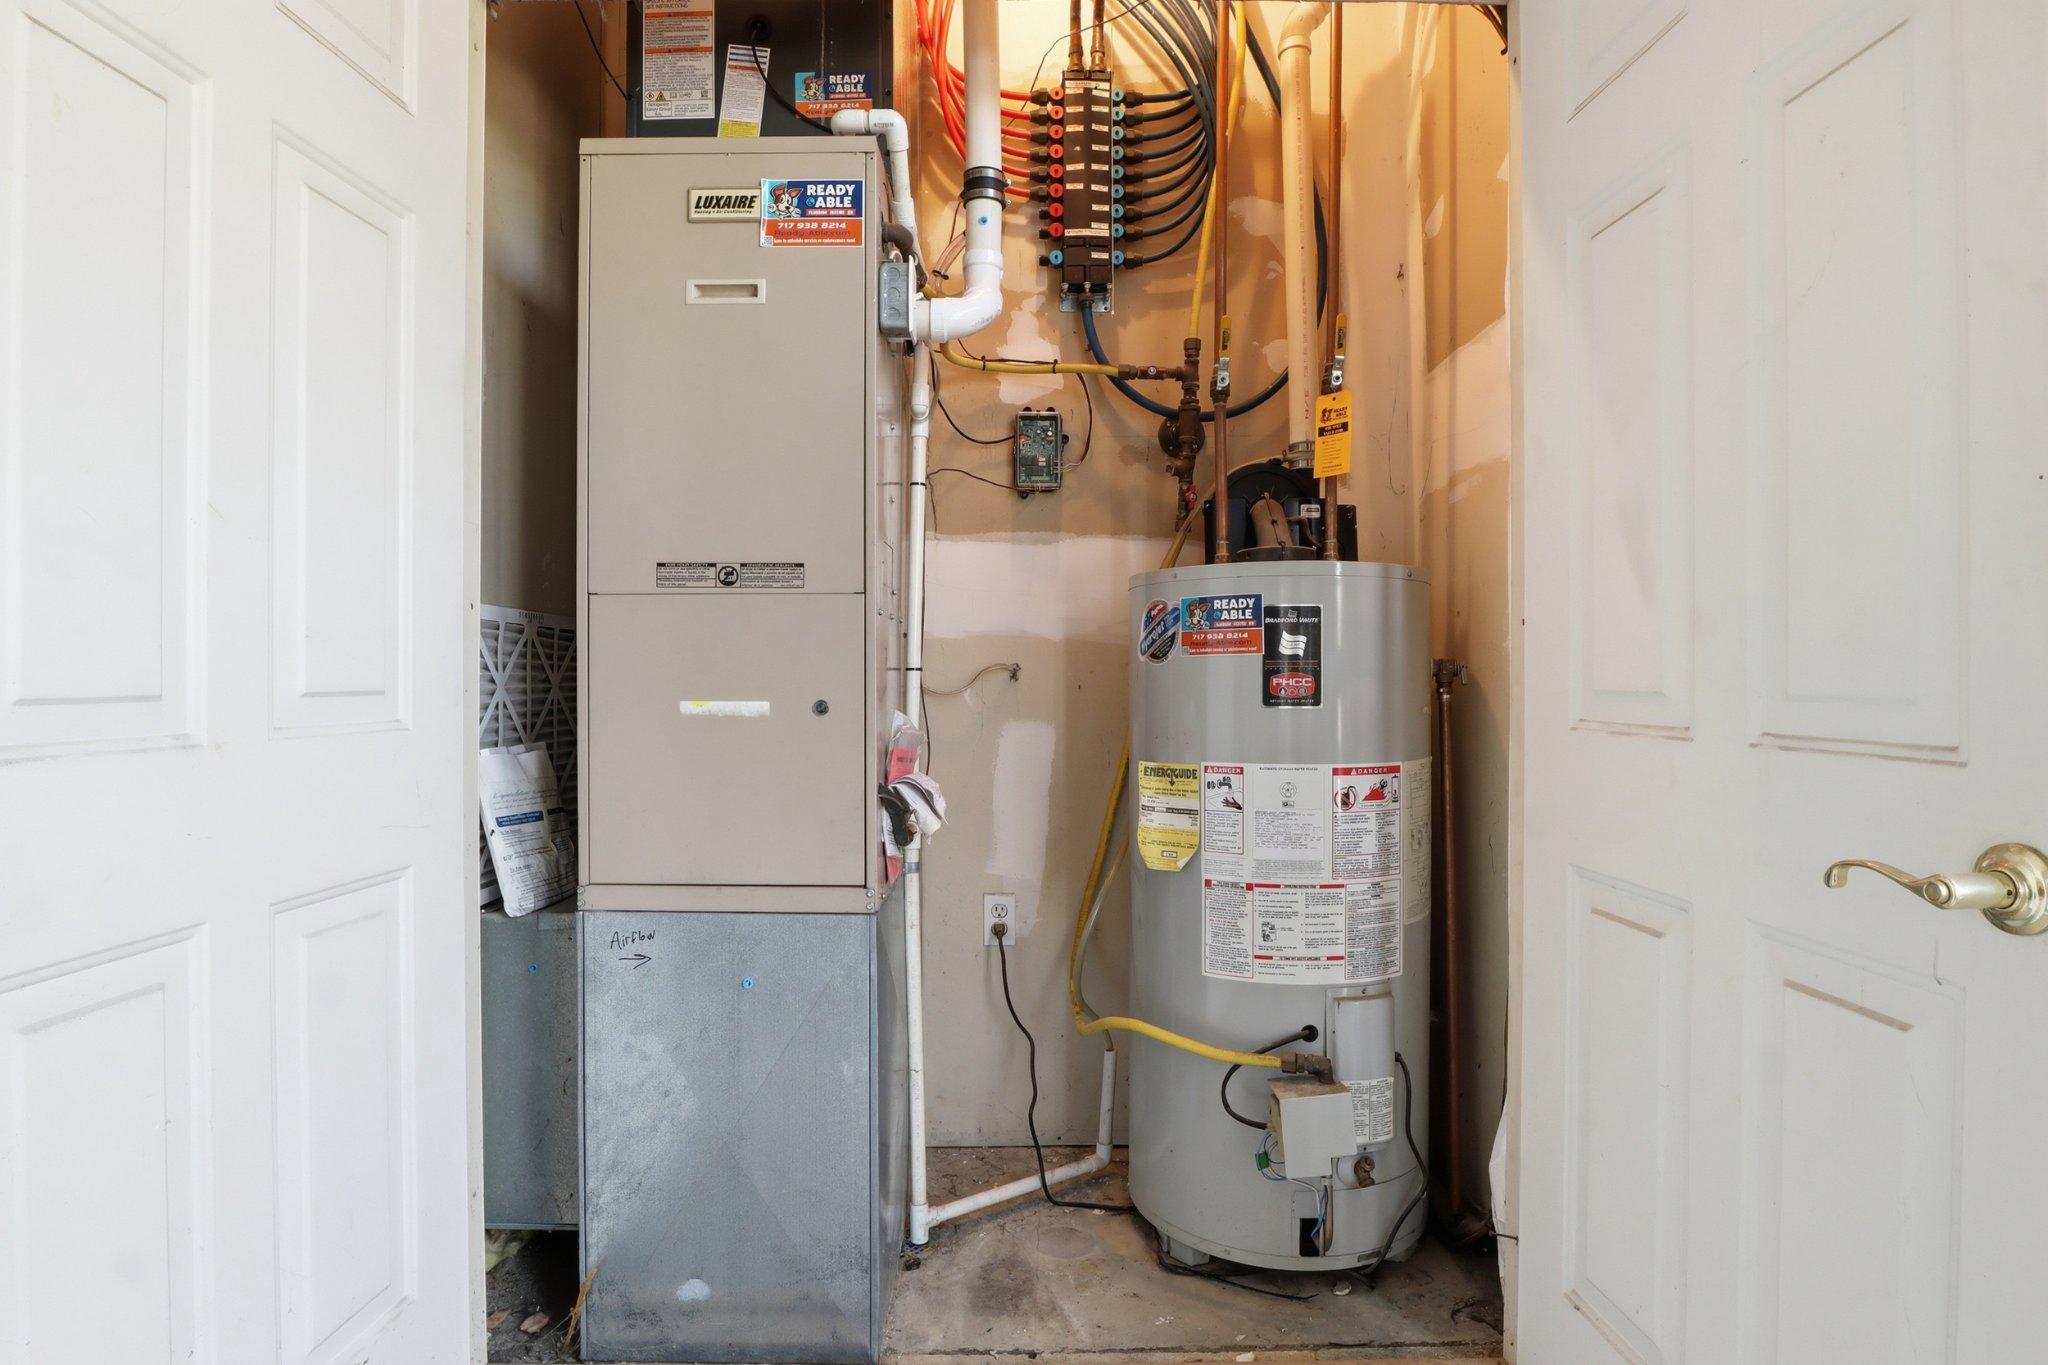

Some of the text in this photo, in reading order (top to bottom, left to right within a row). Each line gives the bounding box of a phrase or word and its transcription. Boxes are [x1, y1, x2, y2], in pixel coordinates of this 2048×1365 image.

[829, 75, 865, 84] READY
[836, 84, 863, 92] ABLE
[807, 184, 855, 196] READY
[695, 195, 758, 210] LUXAIRE
[814, 197, 852, 208] ABLE
[1213, 598, 1255, 609] READY
[1221, 609, 1253, 620] ABLE
[1273, 678, 1312, 686] PHCC
[1144, 766, 1198, 780] ENERGYGUIDE
[611, 930, 655, 949] Airflow
